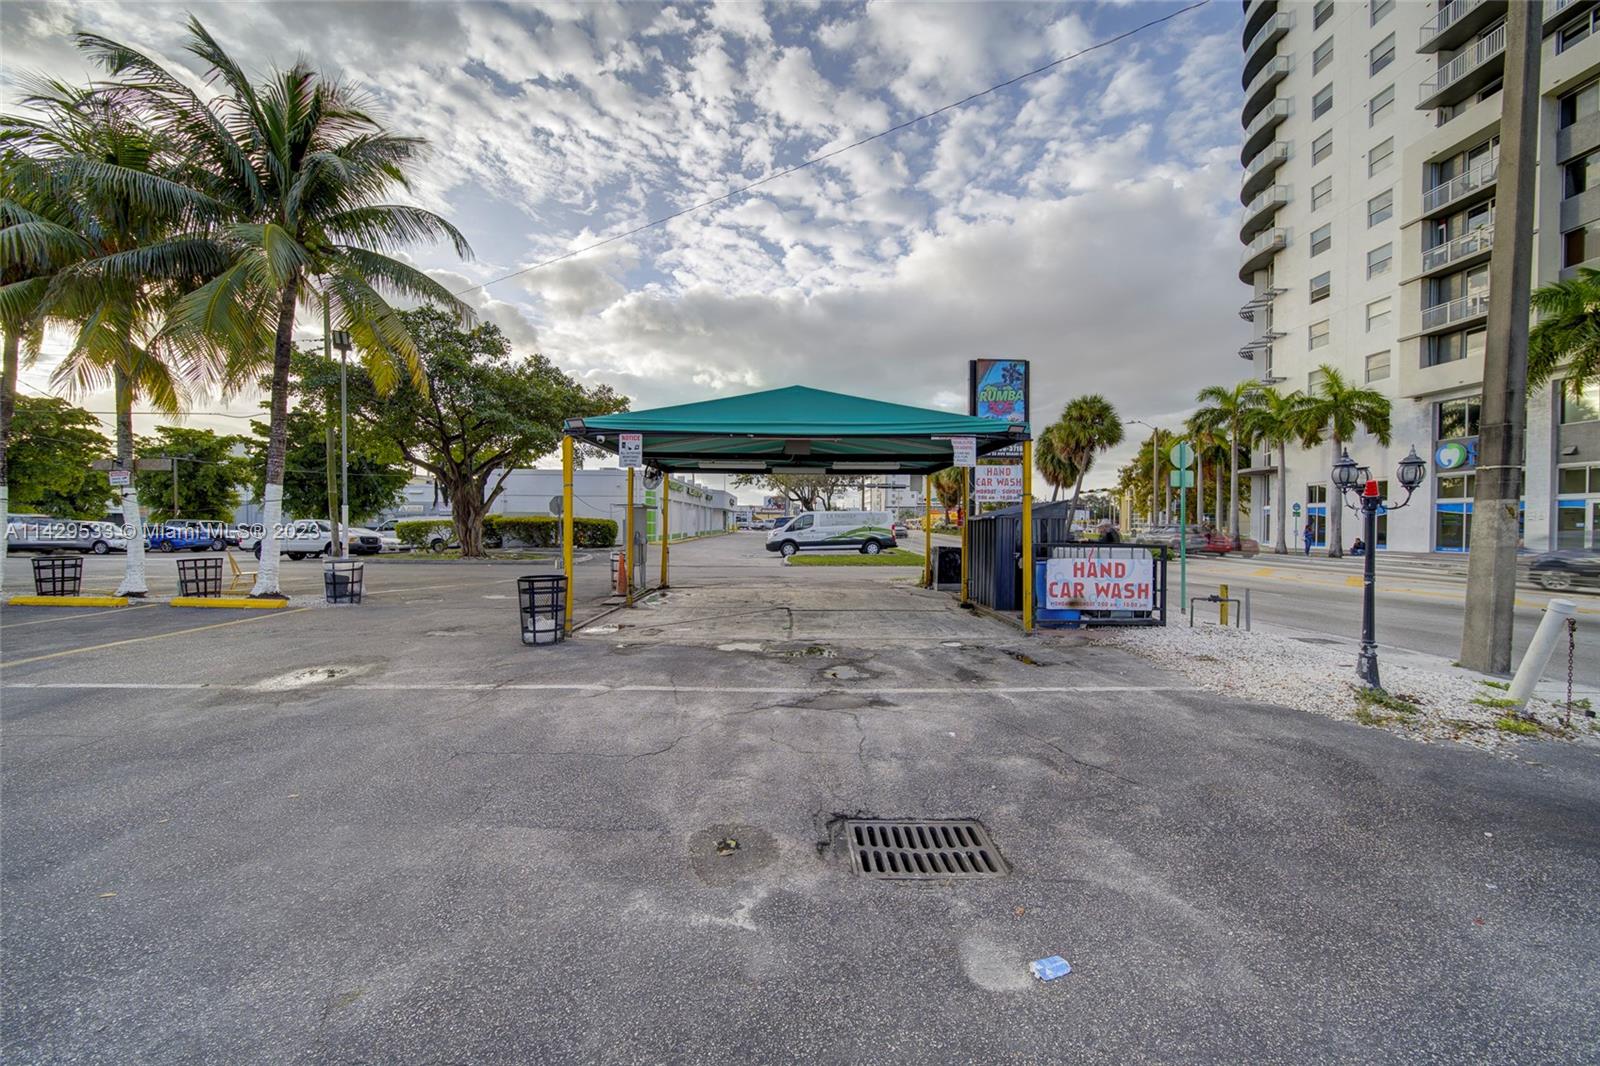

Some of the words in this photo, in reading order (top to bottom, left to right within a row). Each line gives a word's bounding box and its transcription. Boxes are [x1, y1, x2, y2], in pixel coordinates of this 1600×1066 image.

[979, 389, 1024, 401] RUMBA
[986, 467, 1011, 476] HAND
[975, 478, 993, 487] CAR
[996, 478, 1022, 487] WASH
[1073, 561, 1126, 578] HAND
[1048, 582, 1085, 598] CAR
[1095, 582, 1149, 599] WASH
